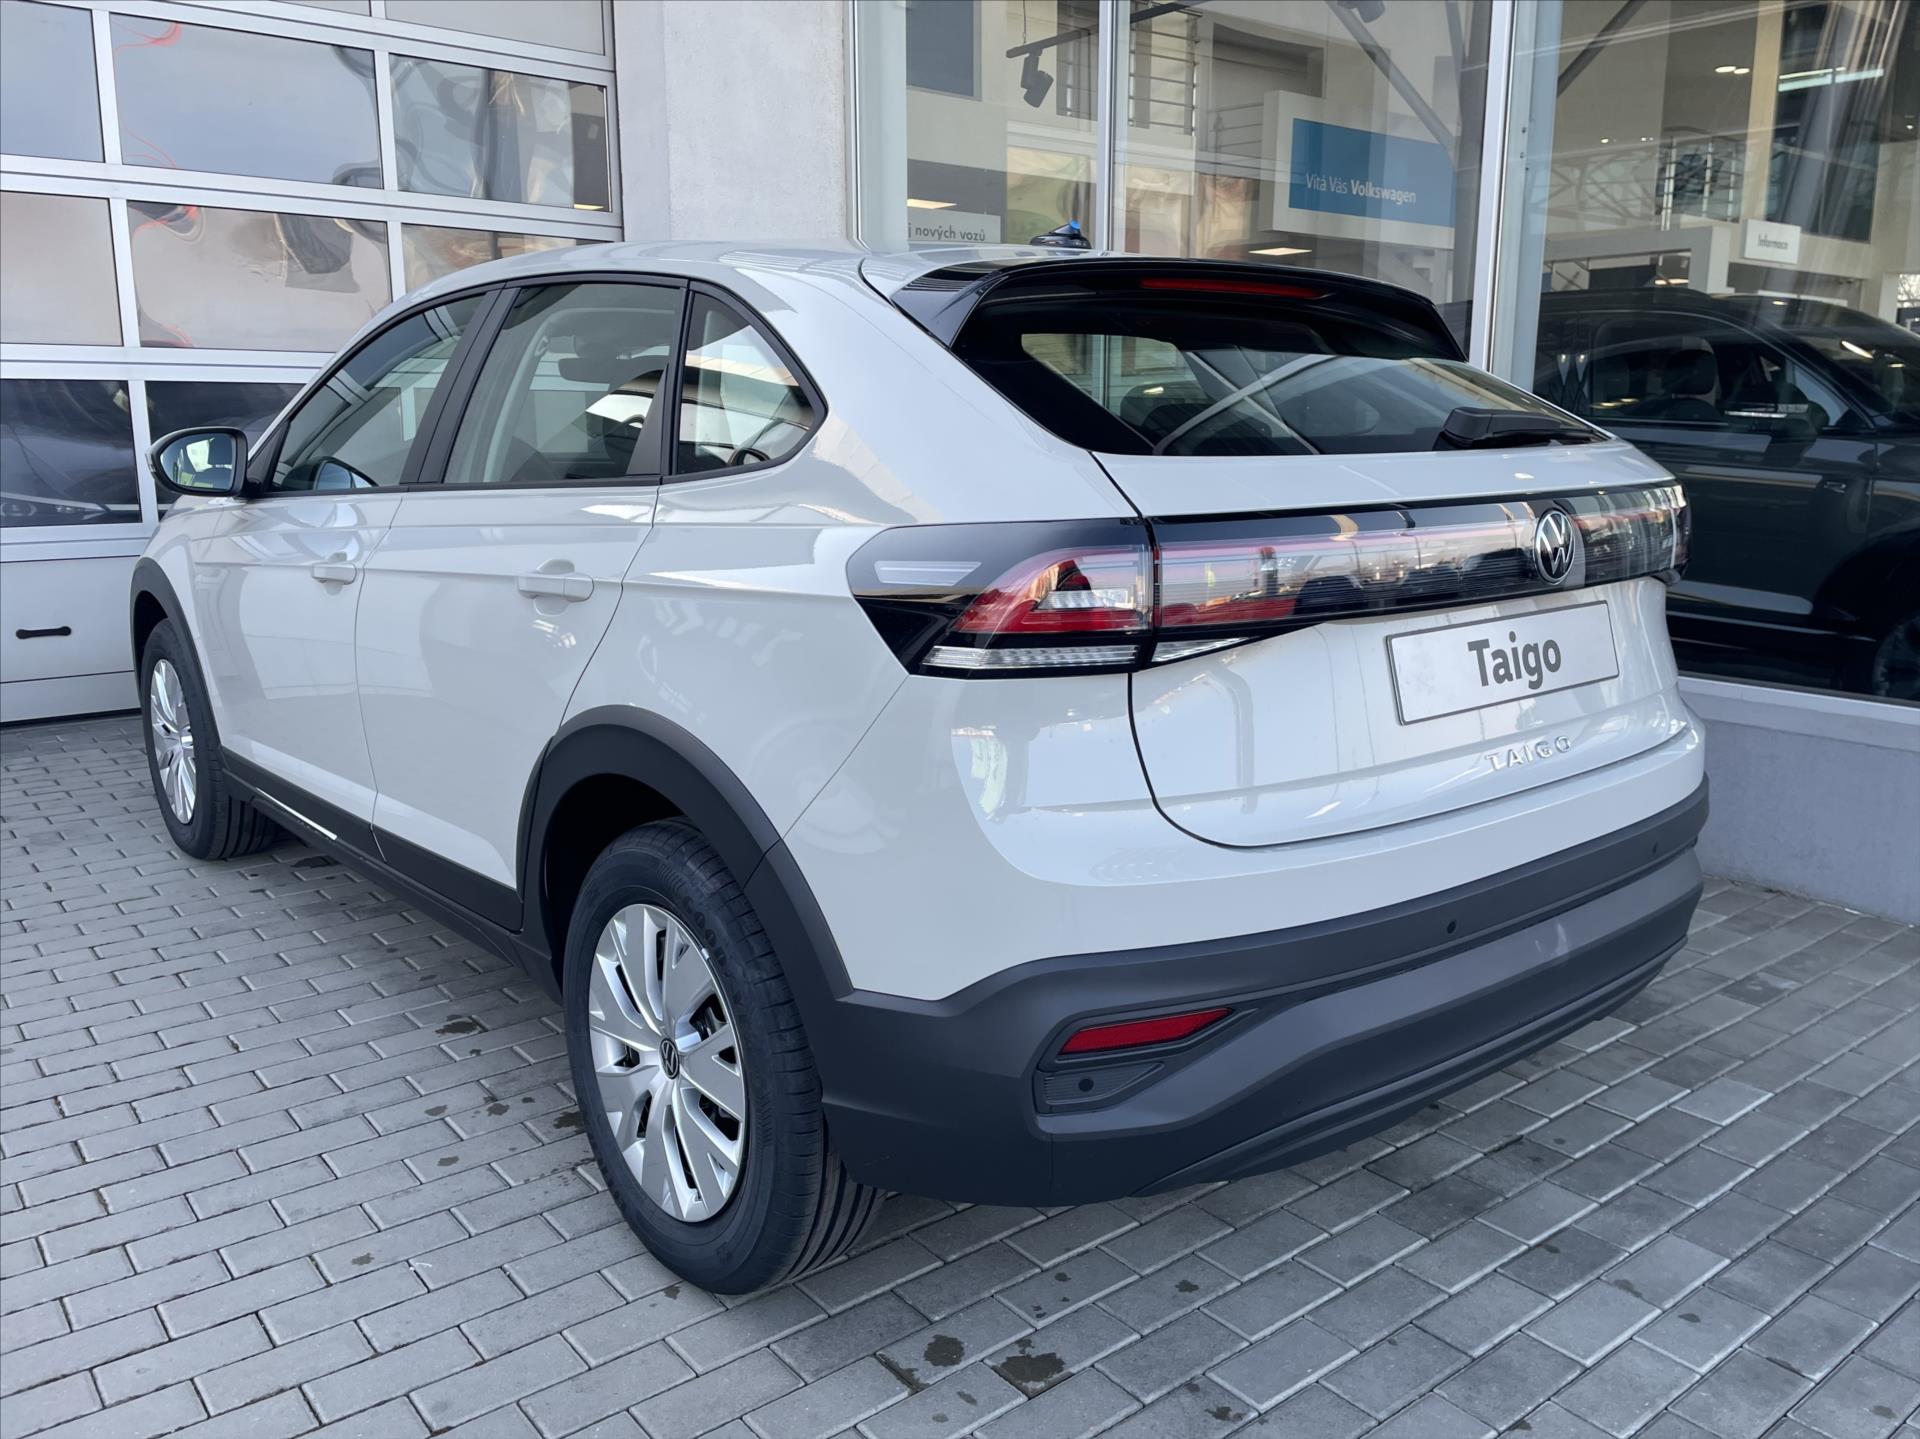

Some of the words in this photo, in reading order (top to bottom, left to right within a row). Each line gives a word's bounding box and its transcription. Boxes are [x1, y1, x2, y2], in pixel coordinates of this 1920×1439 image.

[1351, 179, 1417, 206] Volkswagen
[915, 224, 956, 241] nových
[960, 229, 986, 242] vozů
[1467, 631, 1561, 690] Taigo
[1485, 736, 1571, 771] TAIGO
